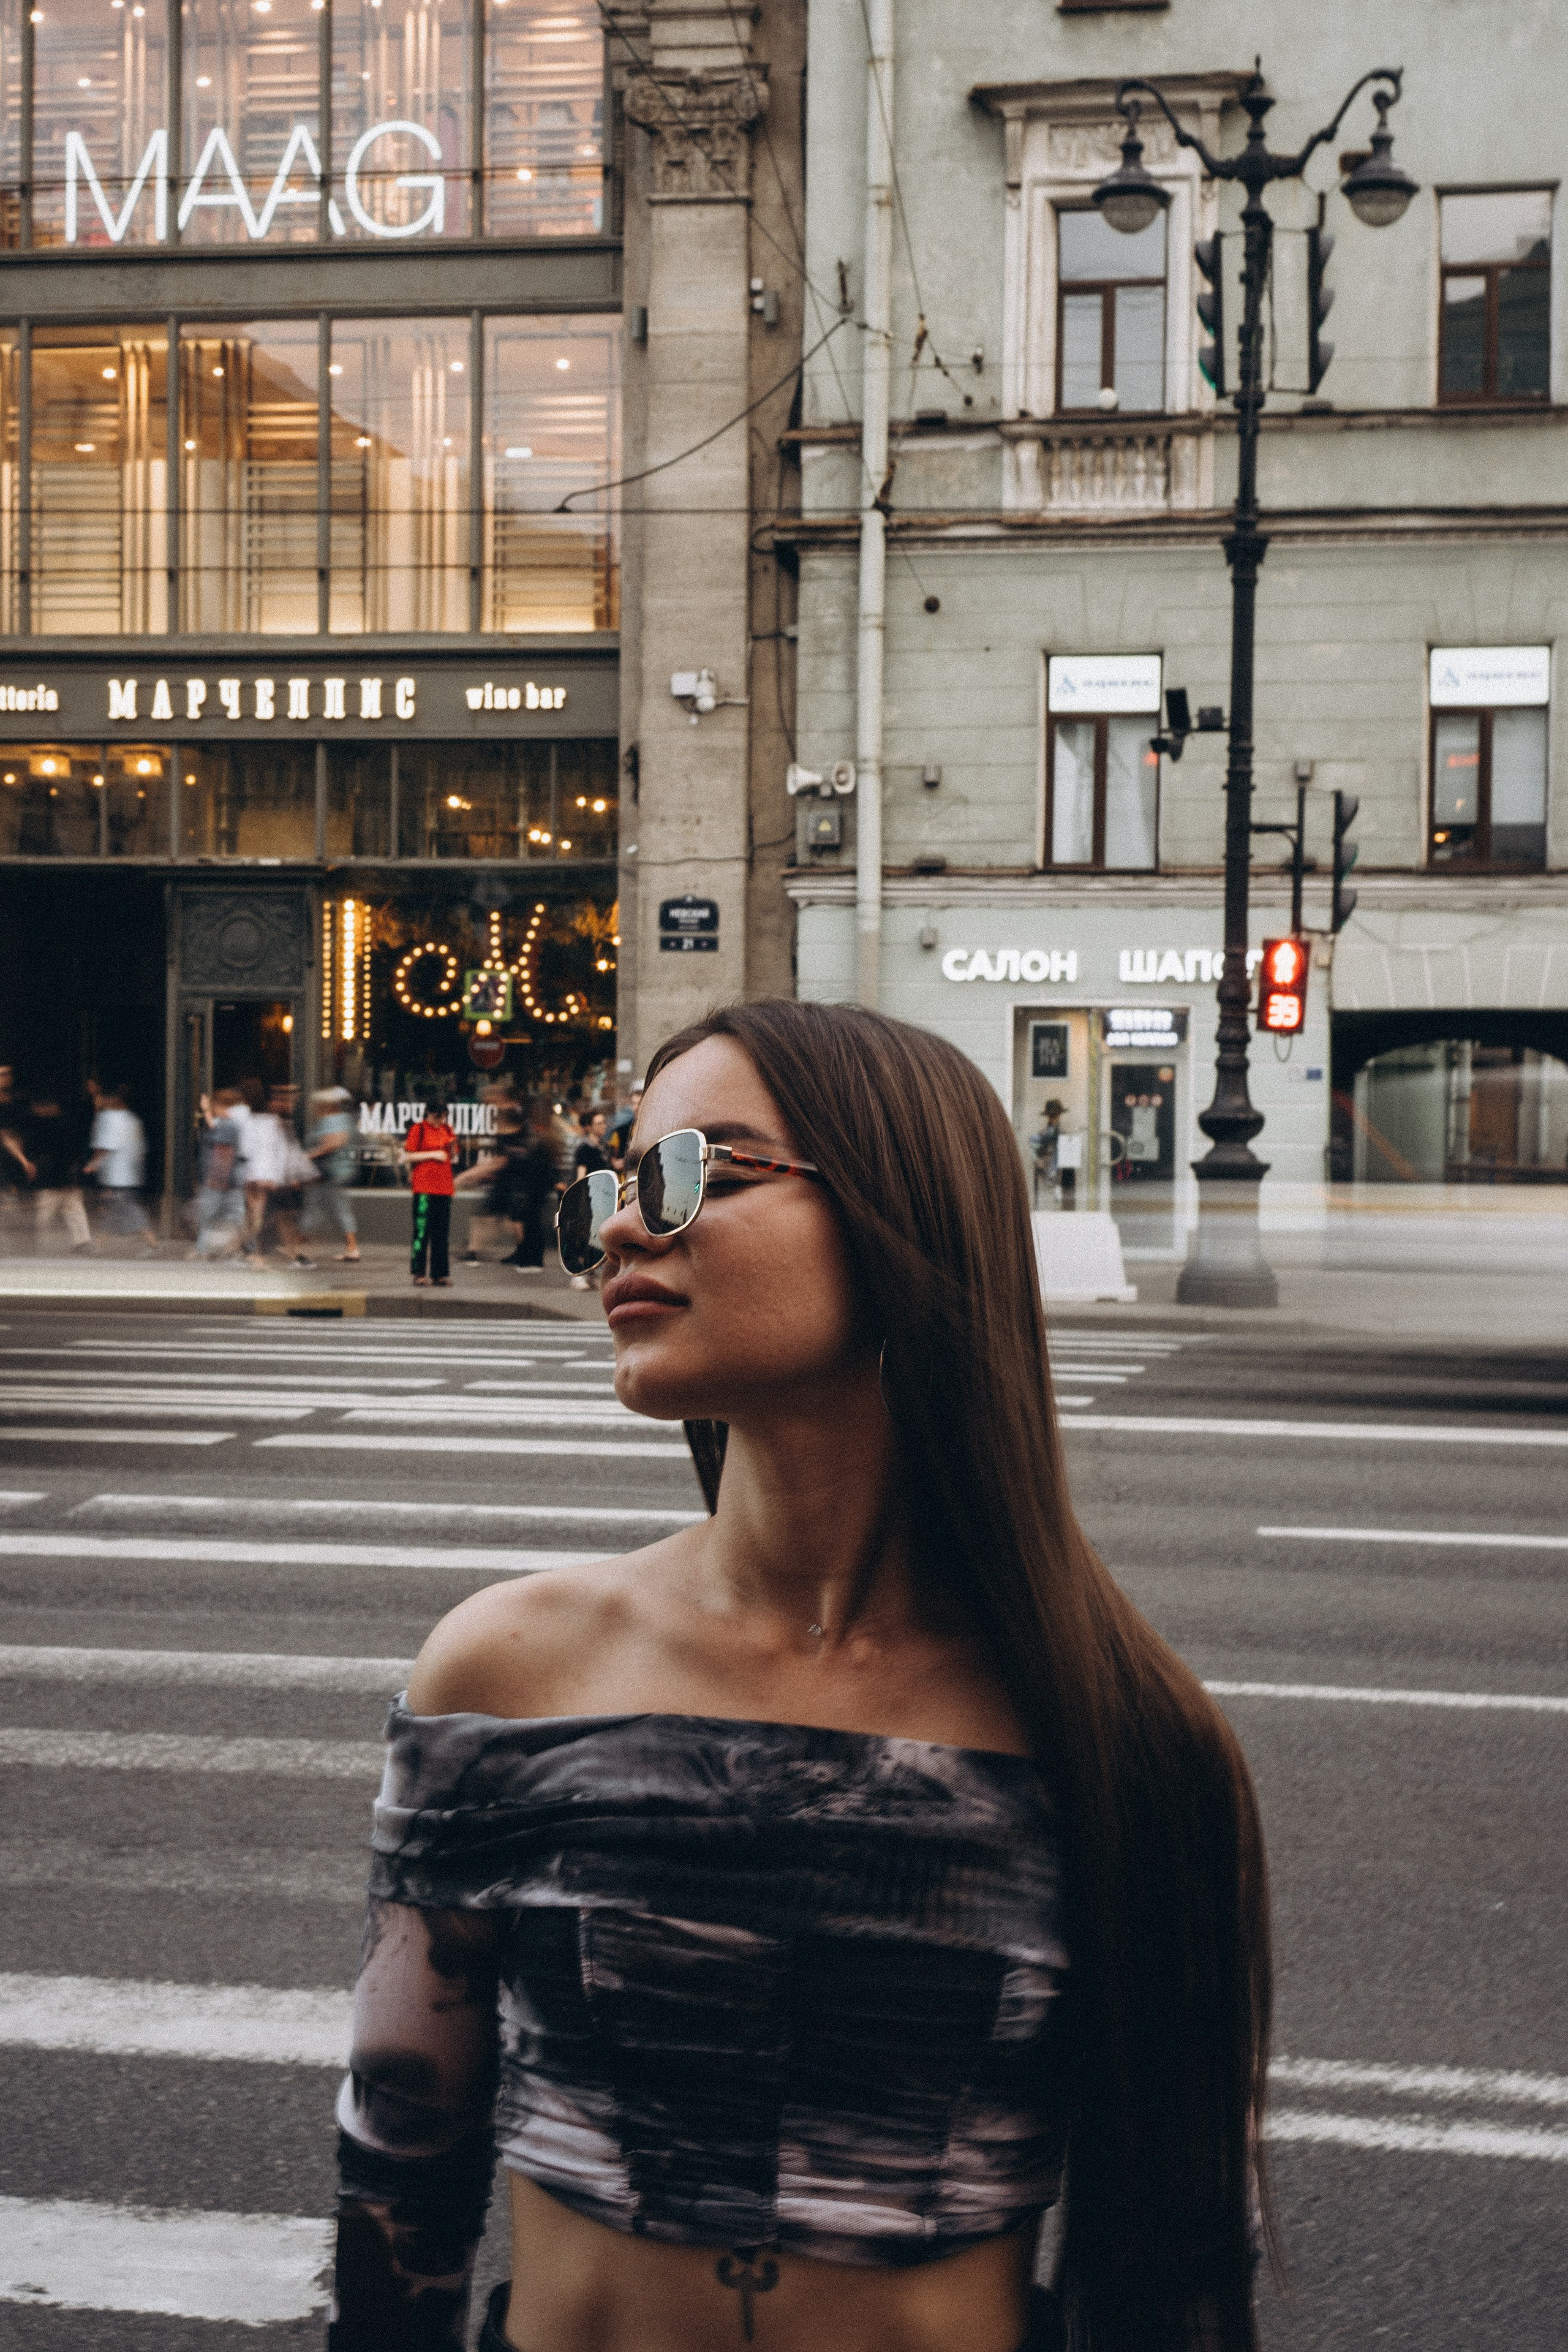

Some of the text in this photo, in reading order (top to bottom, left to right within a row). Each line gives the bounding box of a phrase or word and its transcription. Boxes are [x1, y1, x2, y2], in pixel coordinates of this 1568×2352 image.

[64, 120, 445, 242] MAAG
[526, 682, 566, 709] bar
[942, 949, 1078, 982] САЛОН
[360, 1102, 498, 1135] МАРЧЛИС
